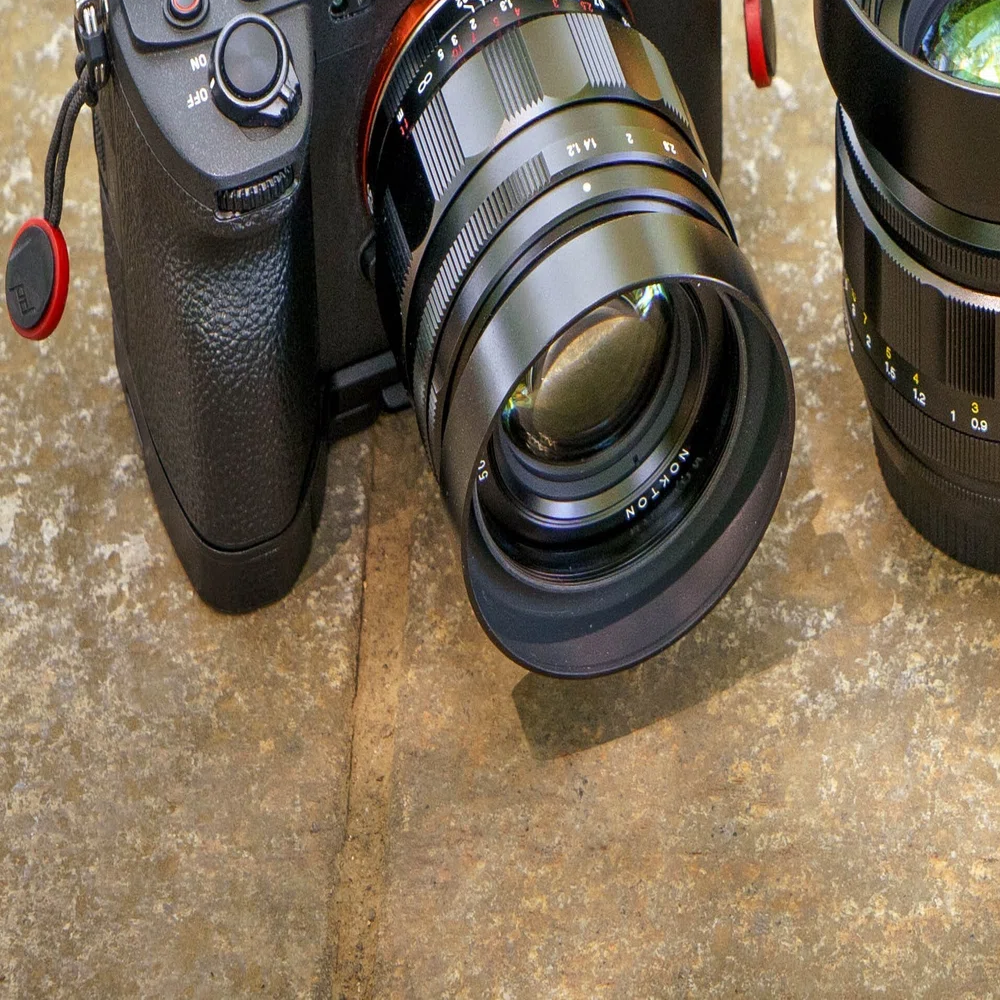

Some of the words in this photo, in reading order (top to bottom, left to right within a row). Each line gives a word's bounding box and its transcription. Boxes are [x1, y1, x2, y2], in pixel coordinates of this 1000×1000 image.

[469, 18, 477, 31] 2
[450, 34, 459, 46] 3
[189, 53, 207, 72] ON
[186, 87, 209, 108] OFF
[625, 132, 634, 144] 2
[865, 334, 872, 349] 2
[912, 387, 927, 407] 1.2
[950, 409, 956, 422] 1
[970, 417, 988, 431] 0.9
[886, 346, 892, 360] 5
[912, 372, 920, 385] 4
[971, 401, 979, 413] 3
[625, 448, 690, 519] NOKTON
